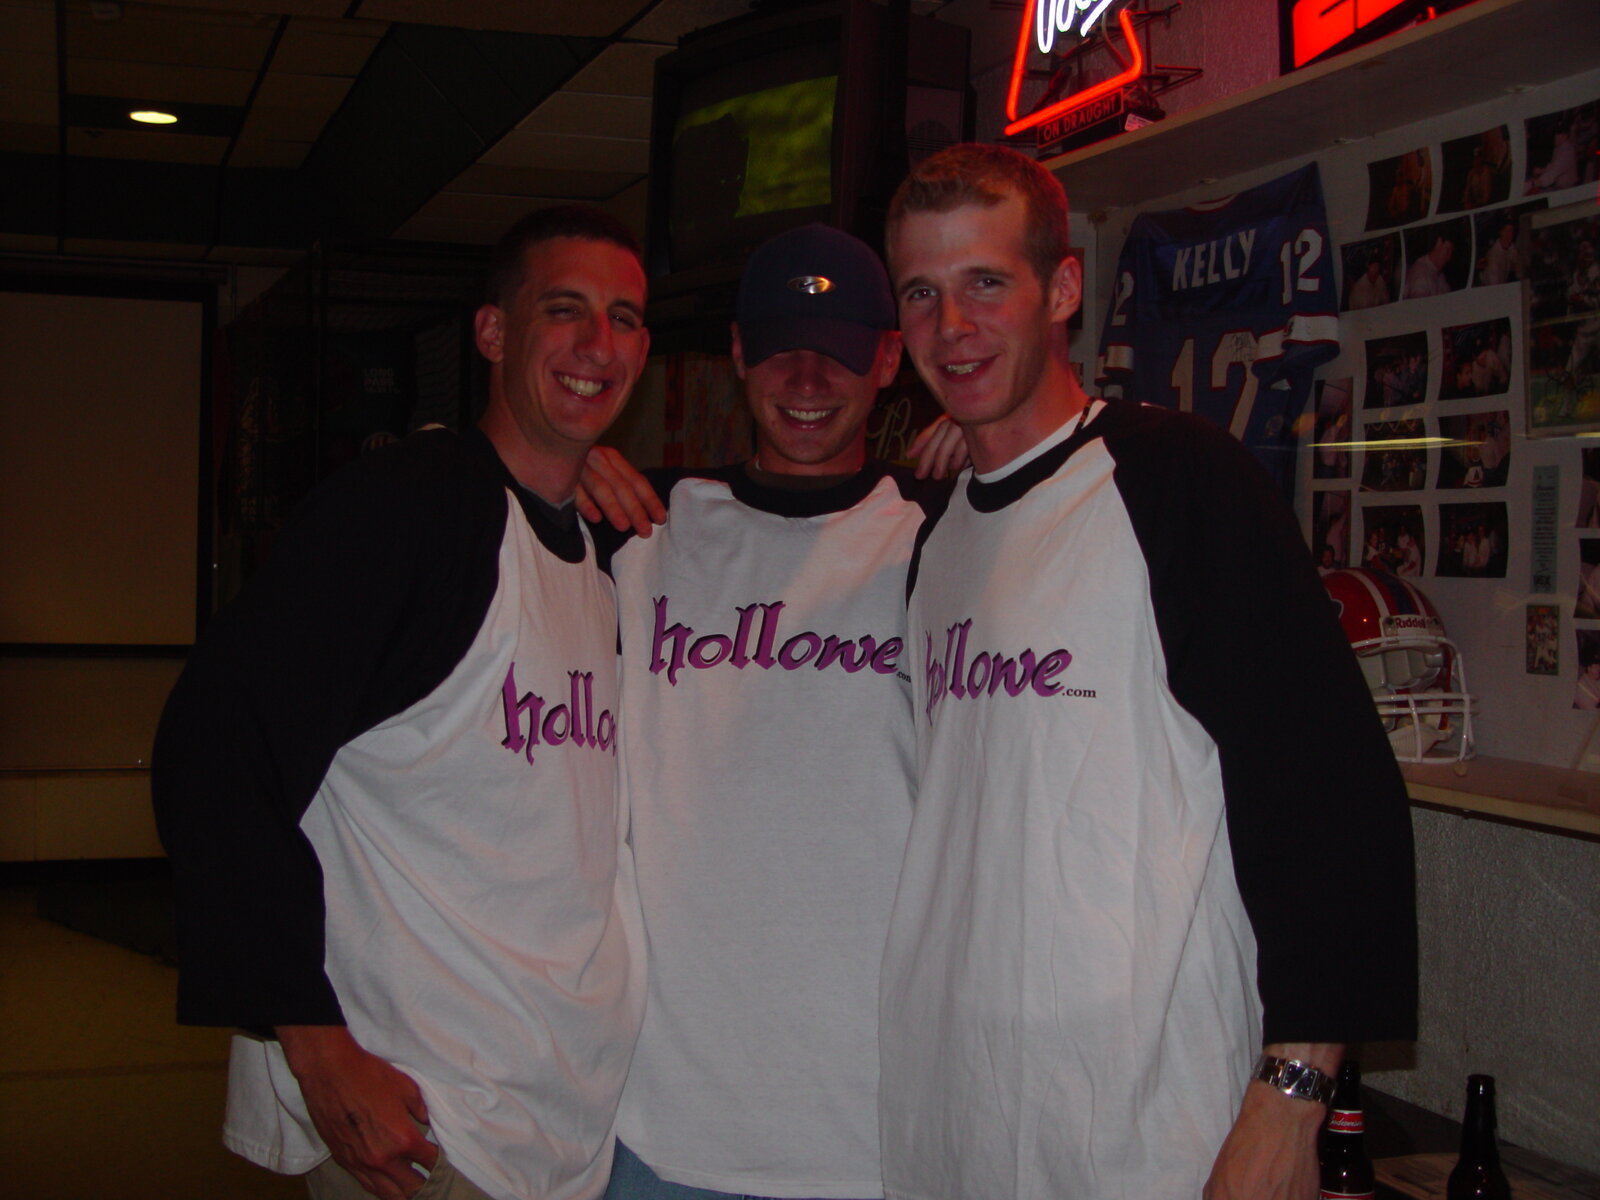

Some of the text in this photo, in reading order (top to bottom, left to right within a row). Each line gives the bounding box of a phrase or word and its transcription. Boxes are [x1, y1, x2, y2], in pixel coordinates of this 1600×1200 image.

[1043, 122, 1060, 142] ON
[1063, 95, 1115, 132] DRAUGHT
[1172, 228, 1257, 292] KELLY
[1280, 227, 1325, 306] 12
[1170, 328, 1260, 442] 12
[500, 661, 616, 766] hollo
